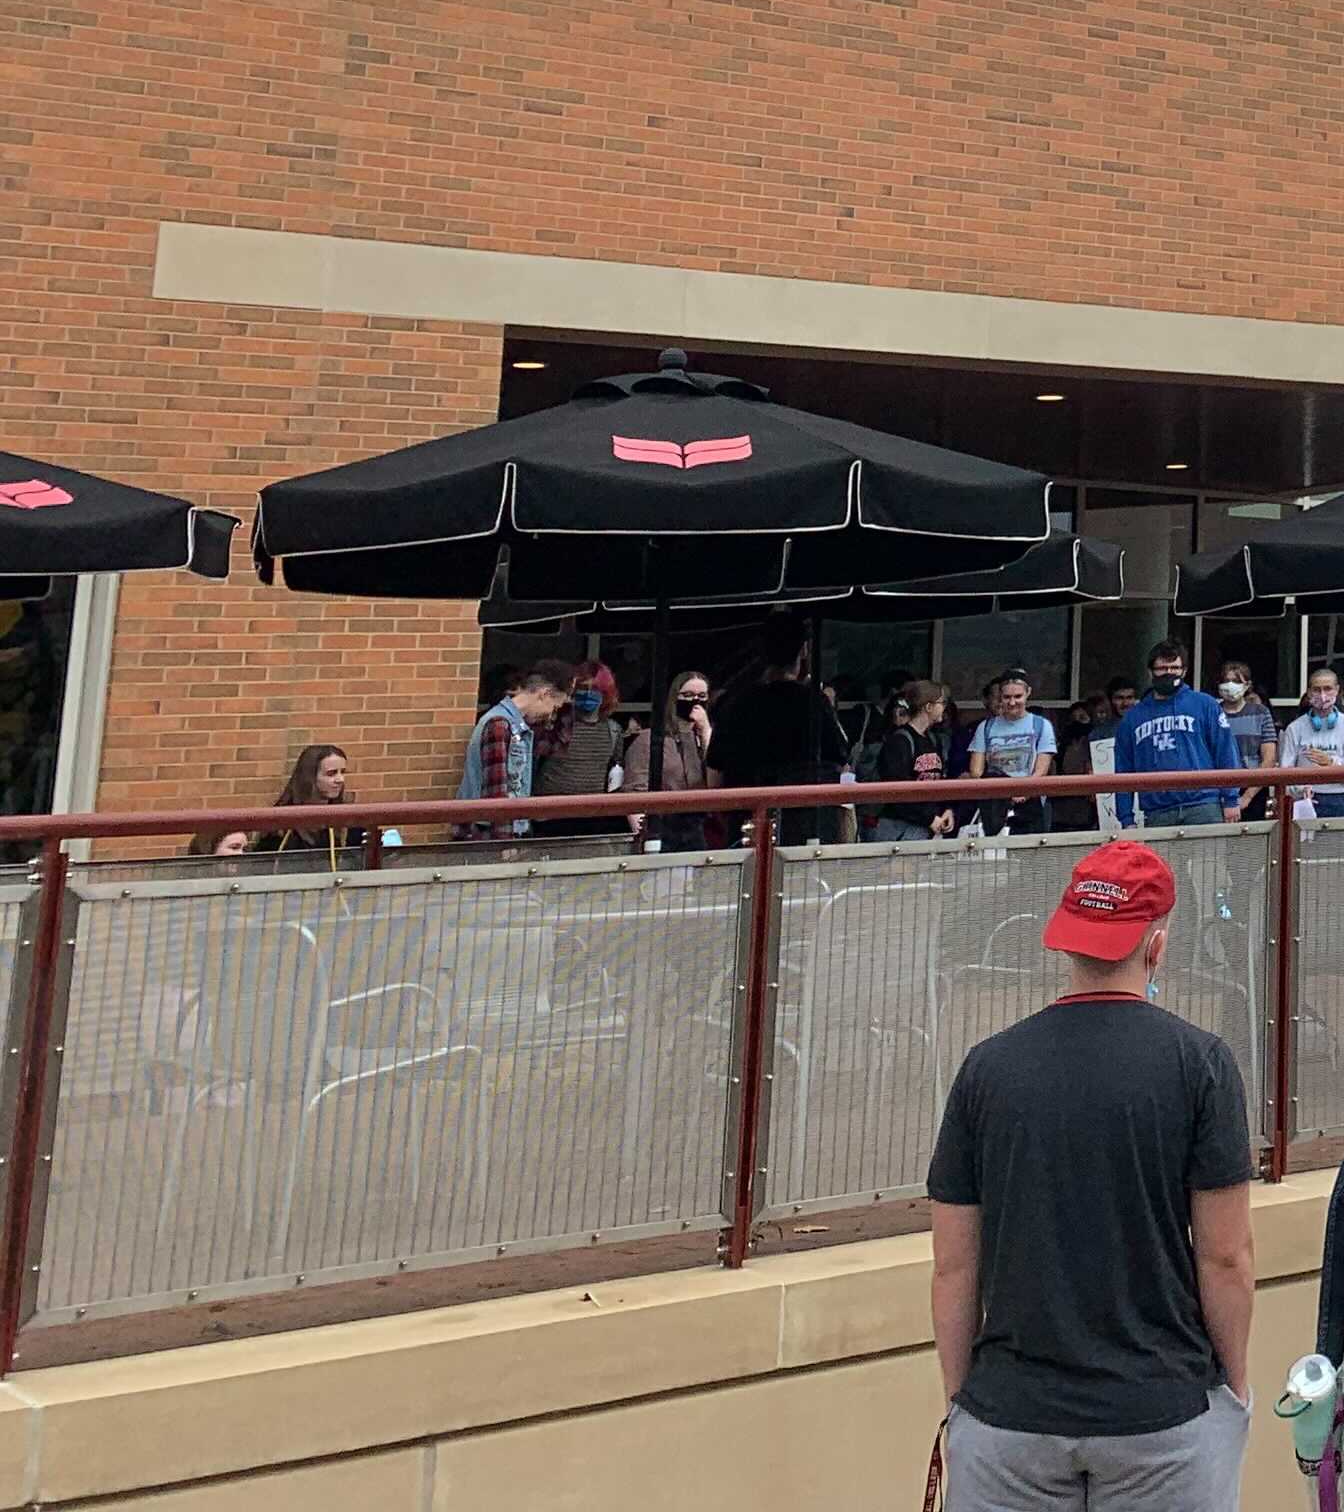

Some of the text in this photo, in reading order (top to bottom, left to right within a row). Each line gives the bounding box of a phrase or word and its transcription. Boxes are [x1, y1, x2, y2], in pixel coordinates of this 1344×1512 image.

[1135, 715, 1195, 745] KENTUCKY
[1074, 880, 1129, 901] GRINNELL
[1080, 899, 1115, 910] FOOTBALL
